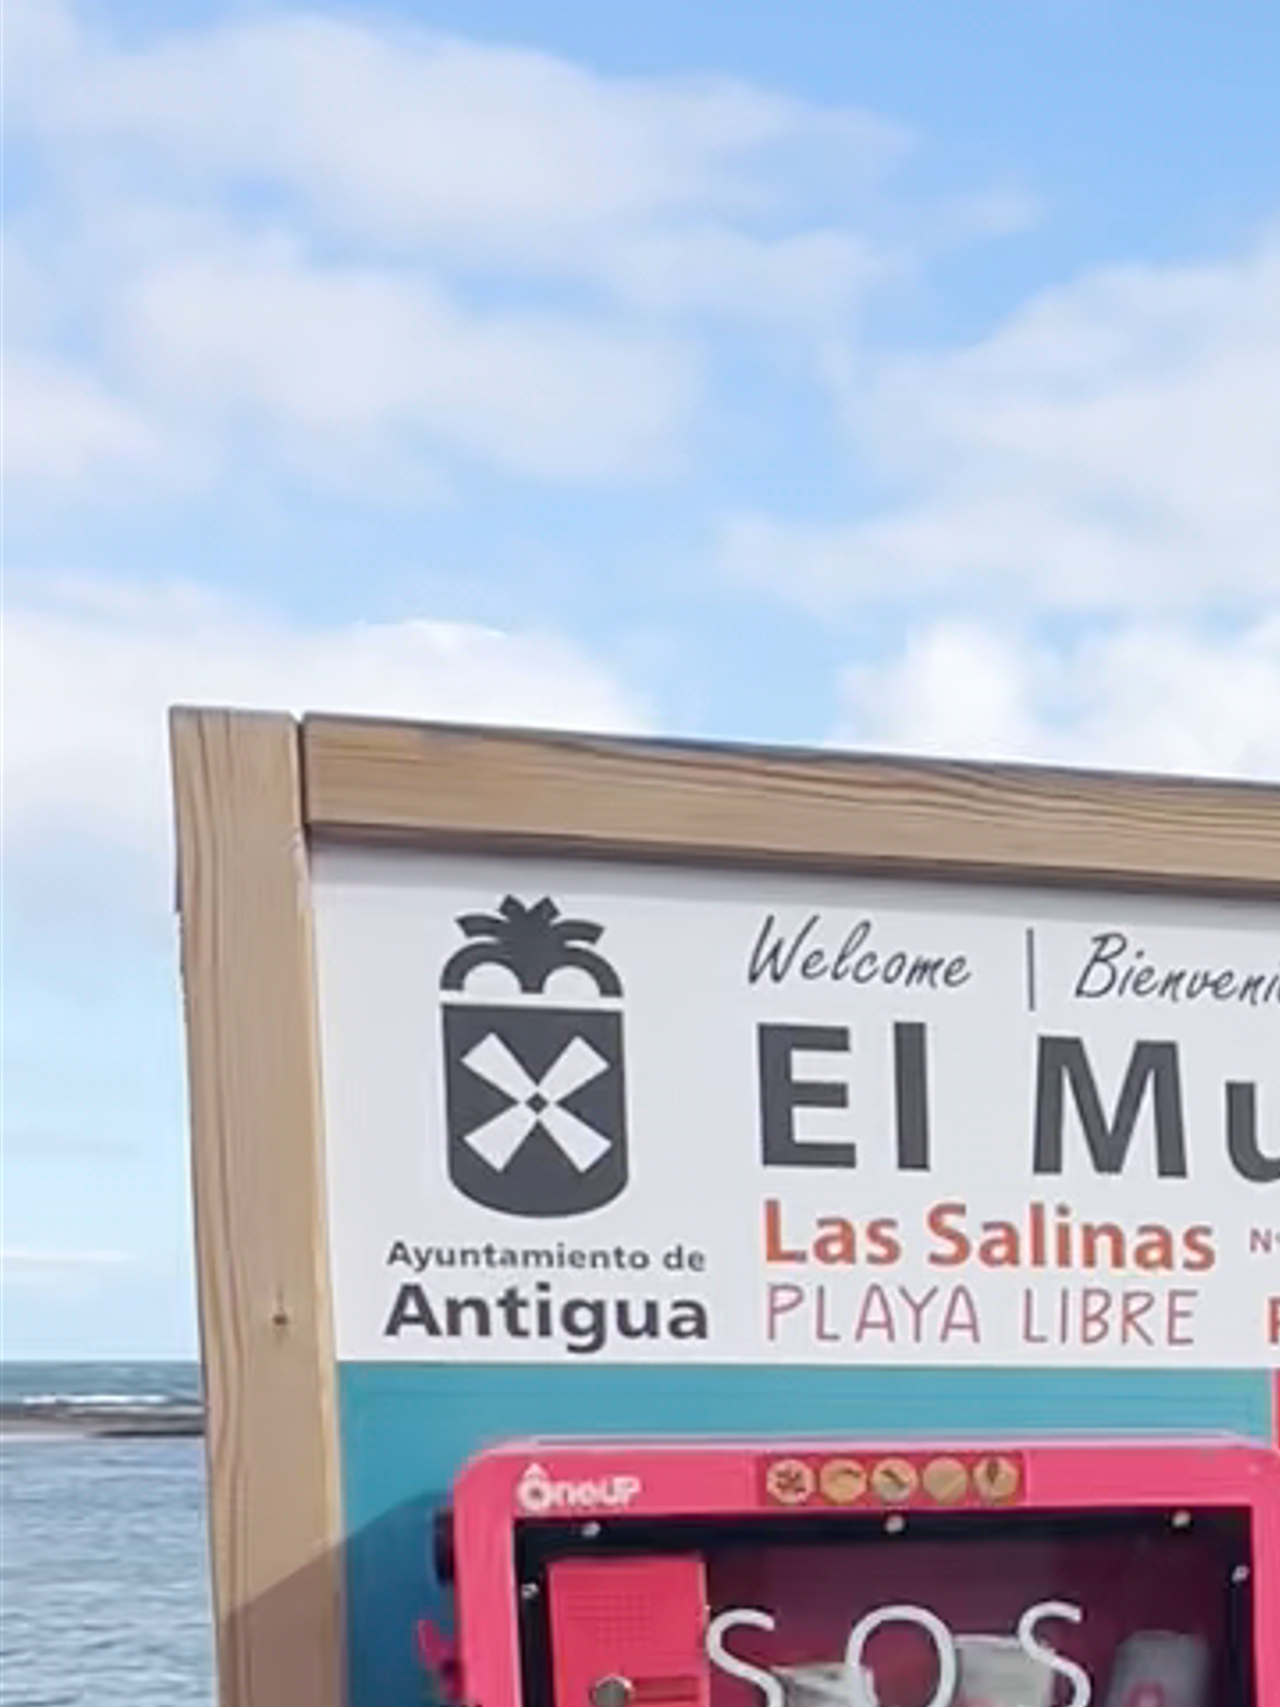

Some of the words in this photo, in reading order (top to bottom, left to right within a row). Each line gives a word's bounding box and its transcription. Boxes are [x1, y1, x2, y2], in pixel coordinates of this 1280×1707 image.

[748, 915, 972, 989] Welcome
[757, 1022, 931, 1172] El
[386, 1239, 651, 1273] Ayuntamiento
[662, 1244, 706, 1272] de
[764, 1199, 902, 1266] Las
[926, 1201, 1217, 1272] Salinas
[384, 1281, 709, 1354] Antigua
[765, 1282, 981, 1344] PLAYA
[1022, 1285, 1200, 1347] LIBRE
